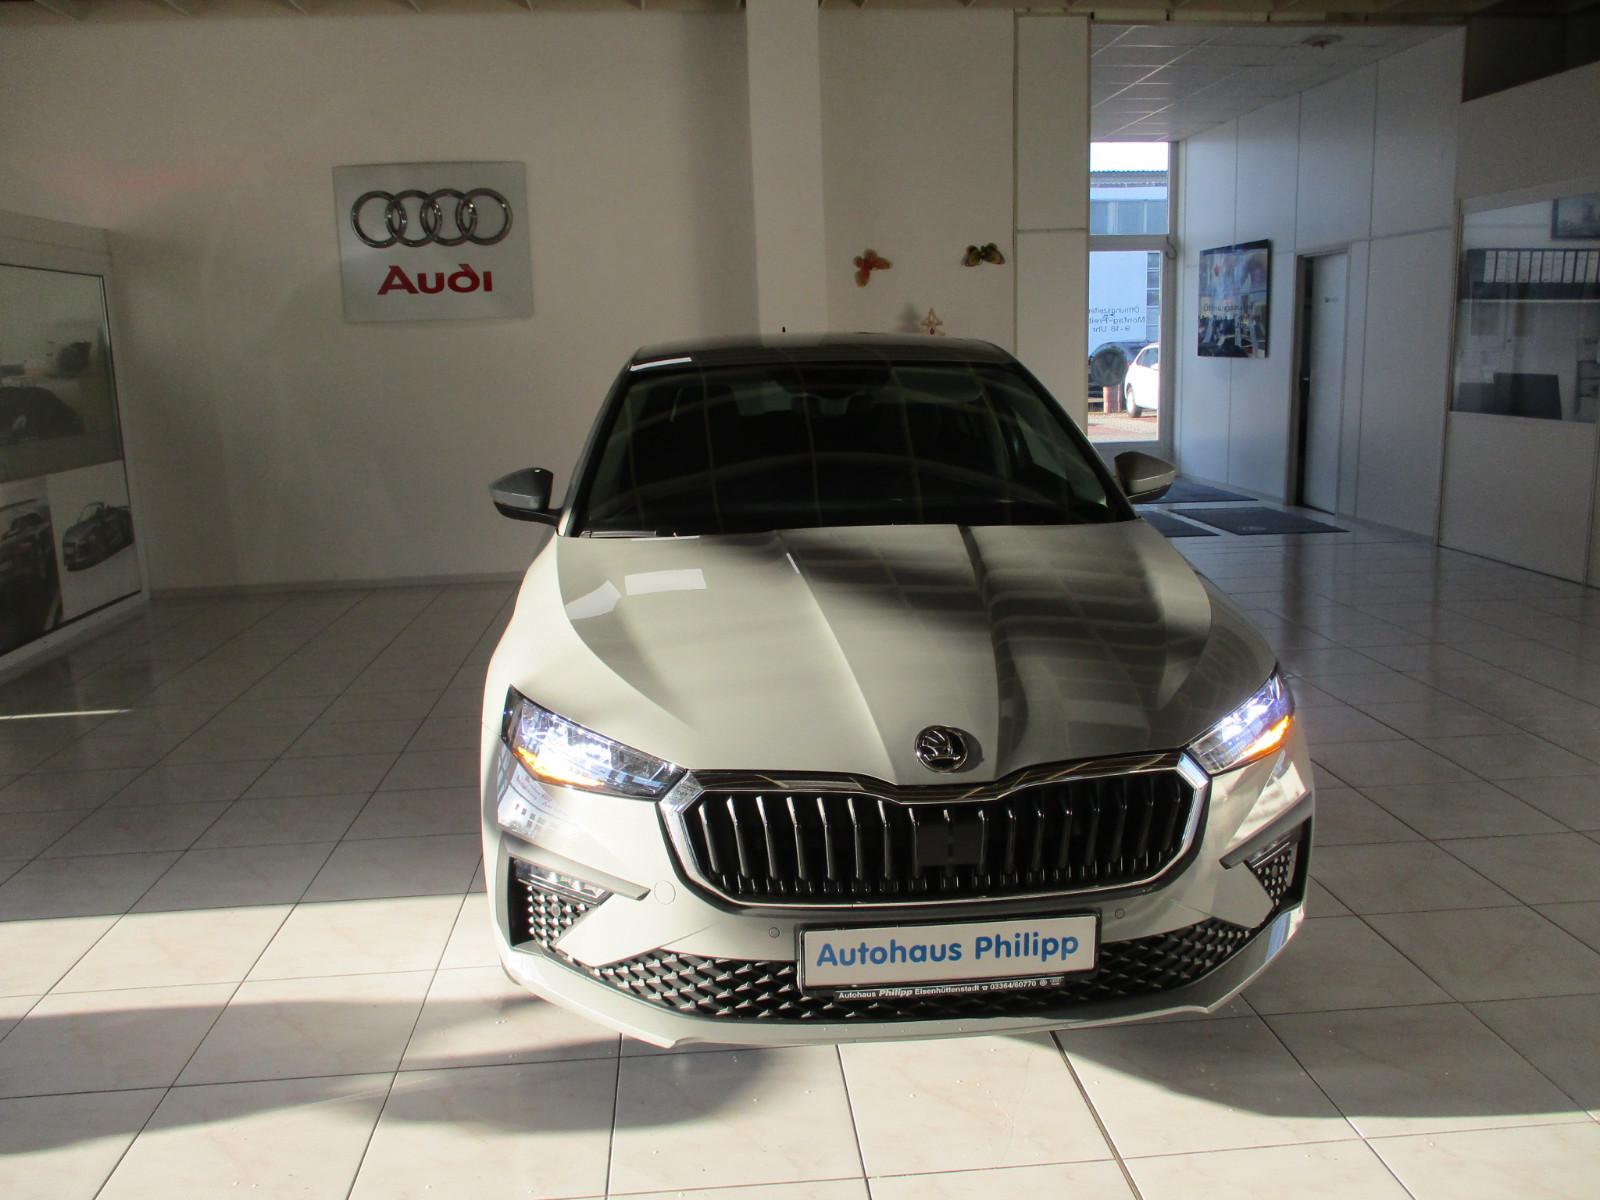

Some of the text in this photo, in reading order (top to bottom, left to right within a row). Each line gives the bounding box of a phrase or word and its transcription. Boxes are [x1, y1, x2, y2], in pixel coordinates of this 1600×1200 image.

[377, 263, 493, 295] Audi
[816, 932, 1079, 967] Autohaus Philipp
[838, 991, 876, 999] Autohaus
[879, 988, 913, 998] Philipp
[914, 984, 980, 995] Eisenhüttenstadt
